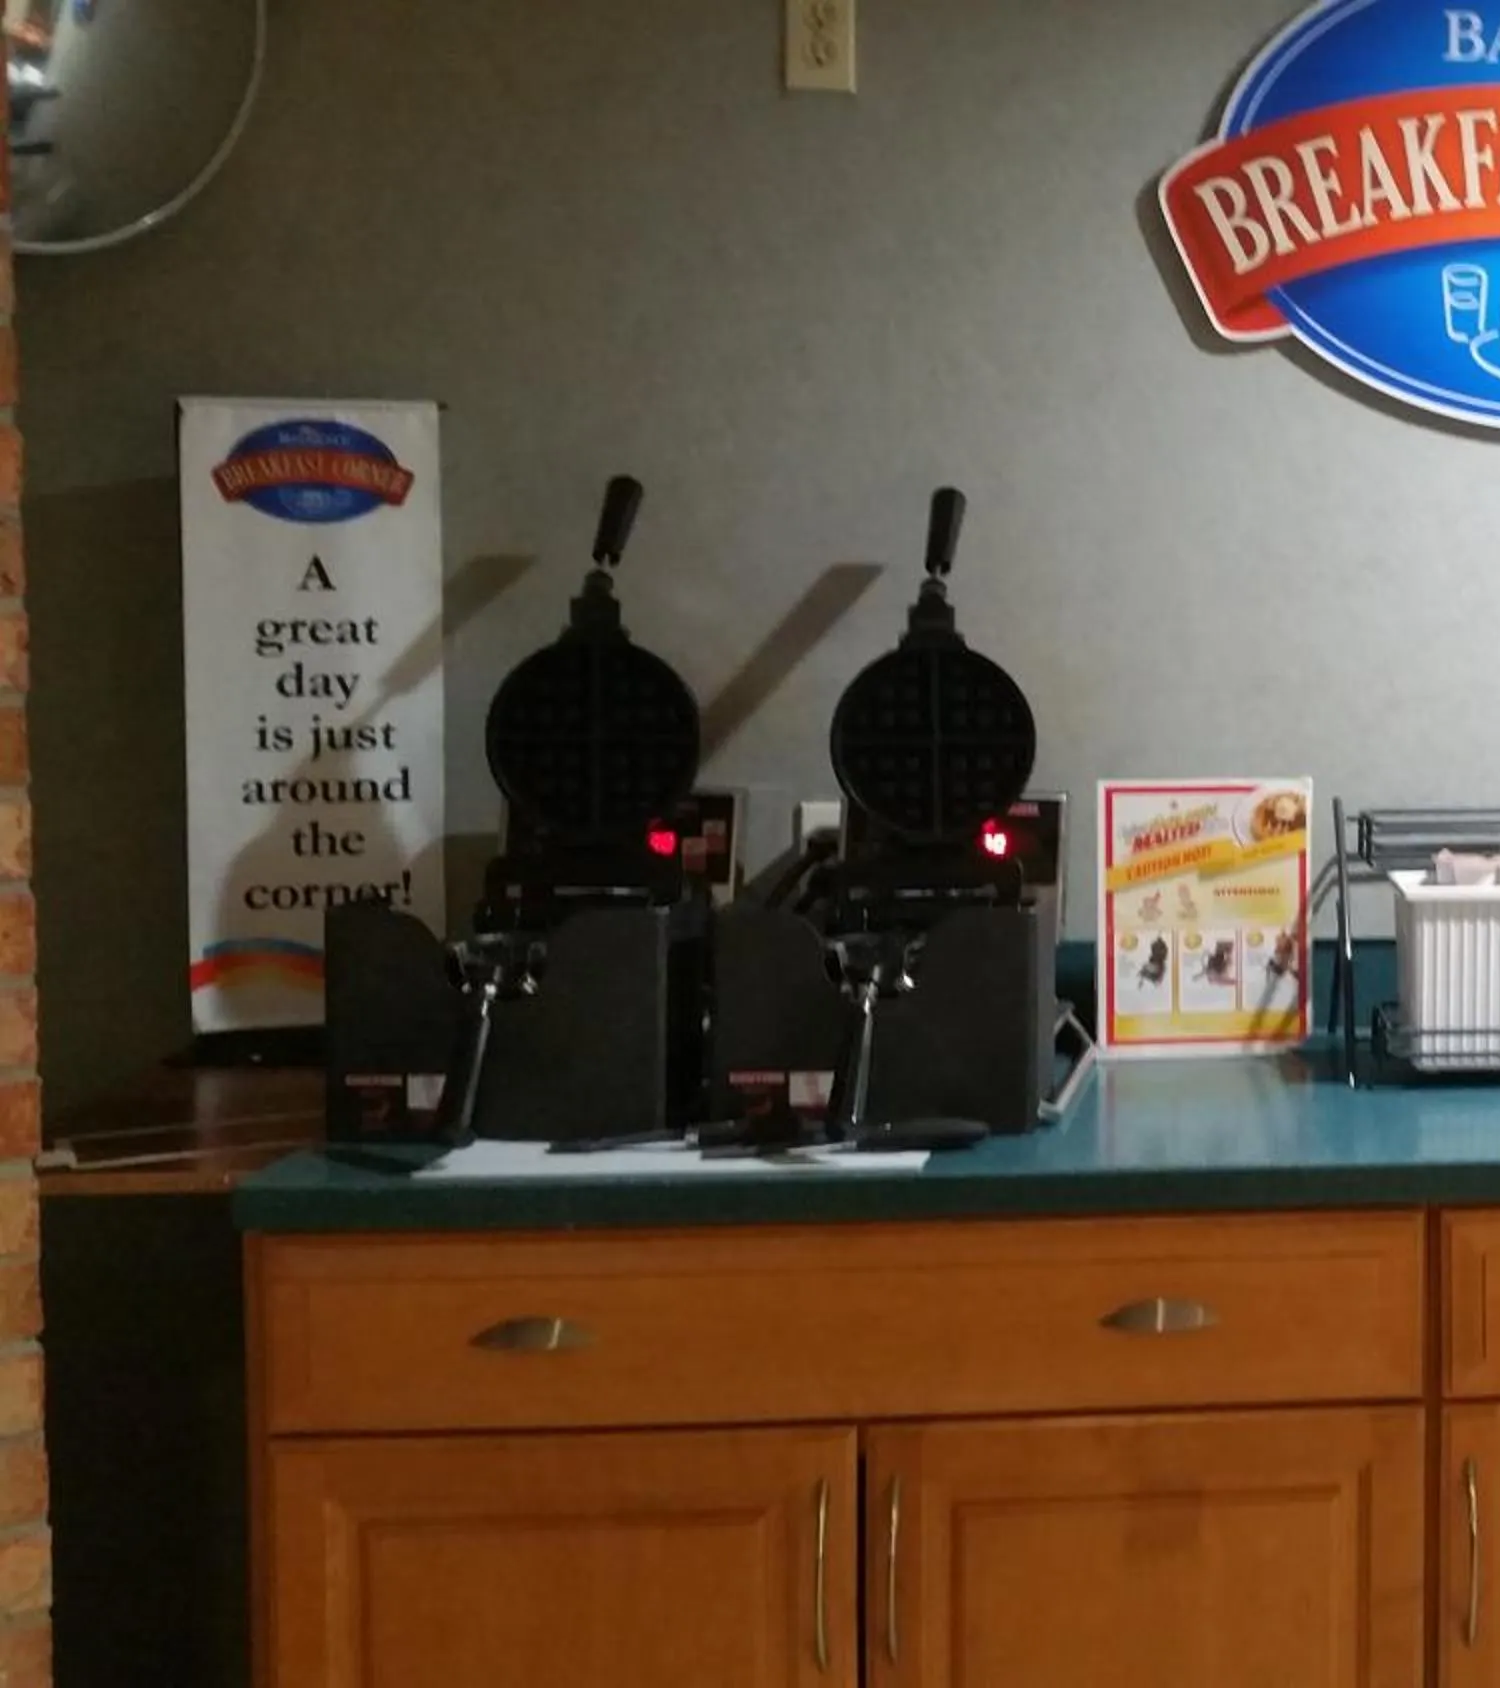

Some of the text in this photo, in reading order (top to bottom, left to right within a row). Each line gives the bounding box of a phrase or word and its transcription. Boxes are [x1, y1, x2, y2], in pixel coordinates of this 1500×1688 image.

[297, 552, 337, 592] A
[255, 616, 380, 658] great
[275, 662, 360, 710] day
[255, 713, 397, 762] is just
[241, 766, 413, 806] around
[292, 821, 366, 858] the
[243, 869, 413, 911] corner!
